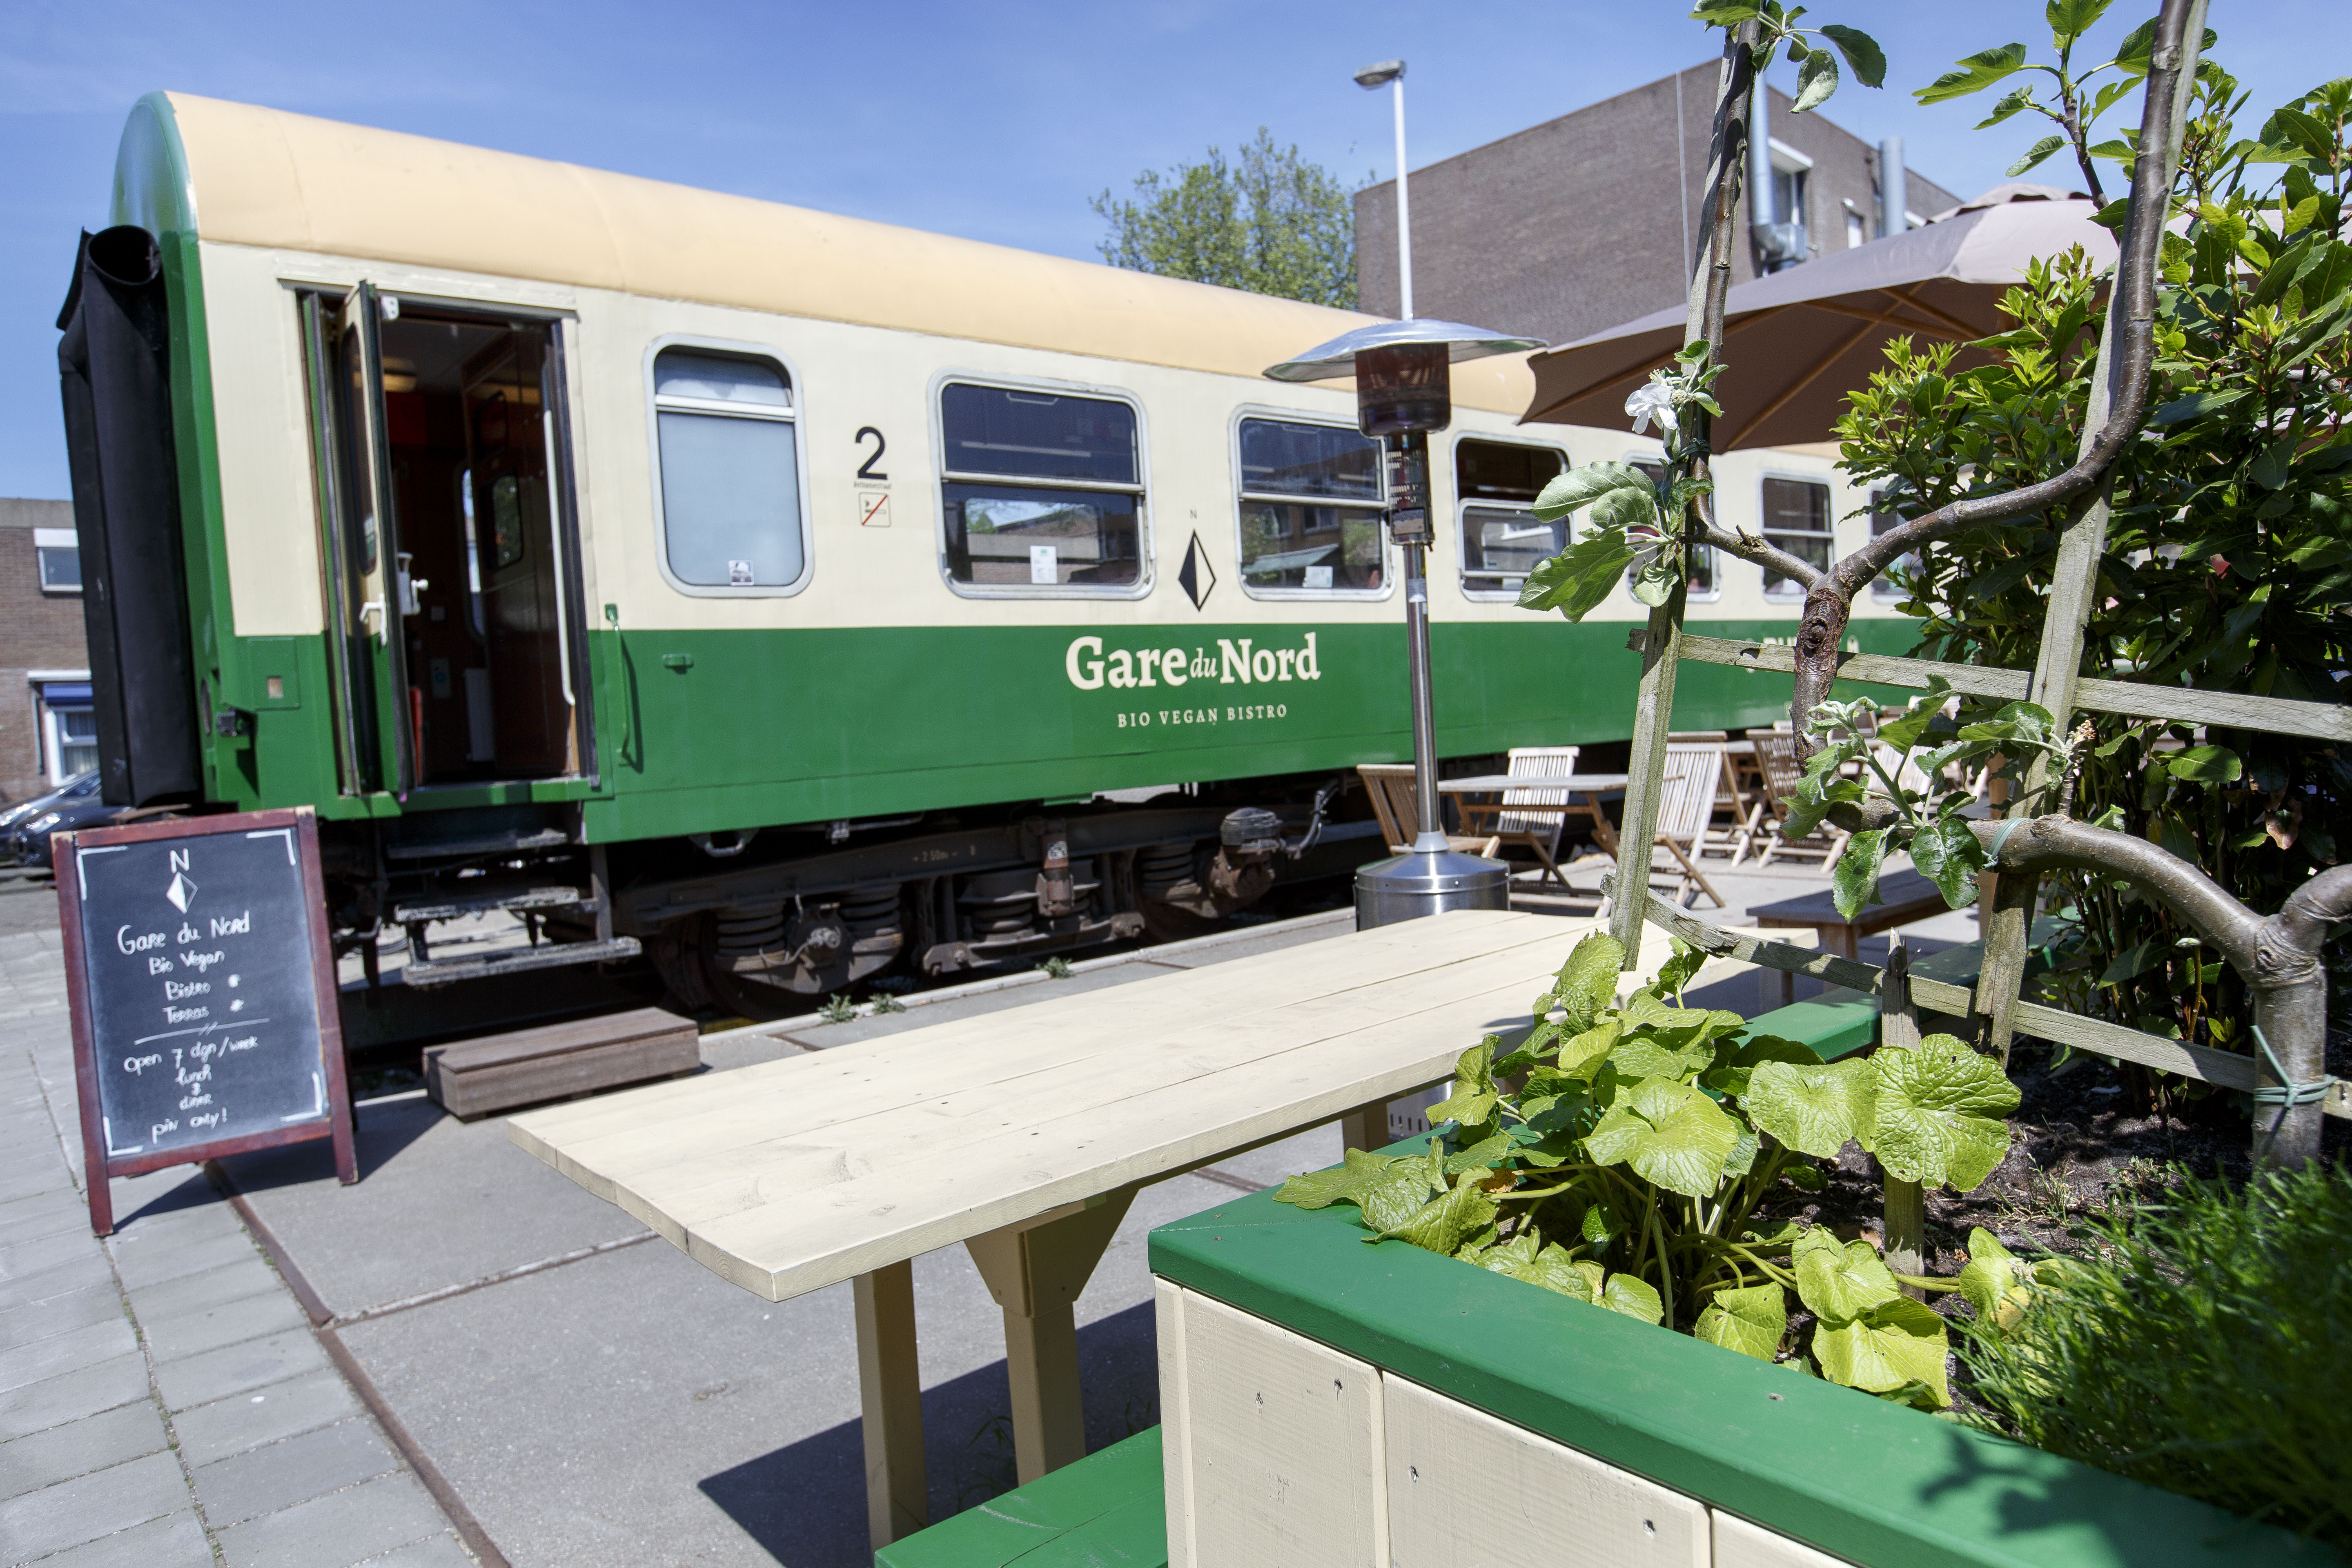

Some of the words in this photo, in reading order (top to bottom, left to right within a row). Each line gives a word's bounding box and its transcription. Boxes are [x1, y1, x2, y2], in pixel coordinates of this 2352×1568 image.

[855, 426, 887, 480] 2
[1065, 635, 1187, 690] Gare
[1190, 647, 1218, 678] du
[1217, 631, 1321, 684] Nord
[1117, 711, 1150, 728] BIO
[1158, 708, 1218, 725] VEGAN
[1227, 704, 1287, 721] BISTRO
[169, 848, 190, 873] N
[177, 921, 202, 944] du
[149, 957, 174, 976] Bio
[179, 950, 225, 973] Vegan
[165, 980, 211, 1000] Bistro
[163, 1006, 209, 1024] Terras
[171, 1048, 183, 1069] 7
